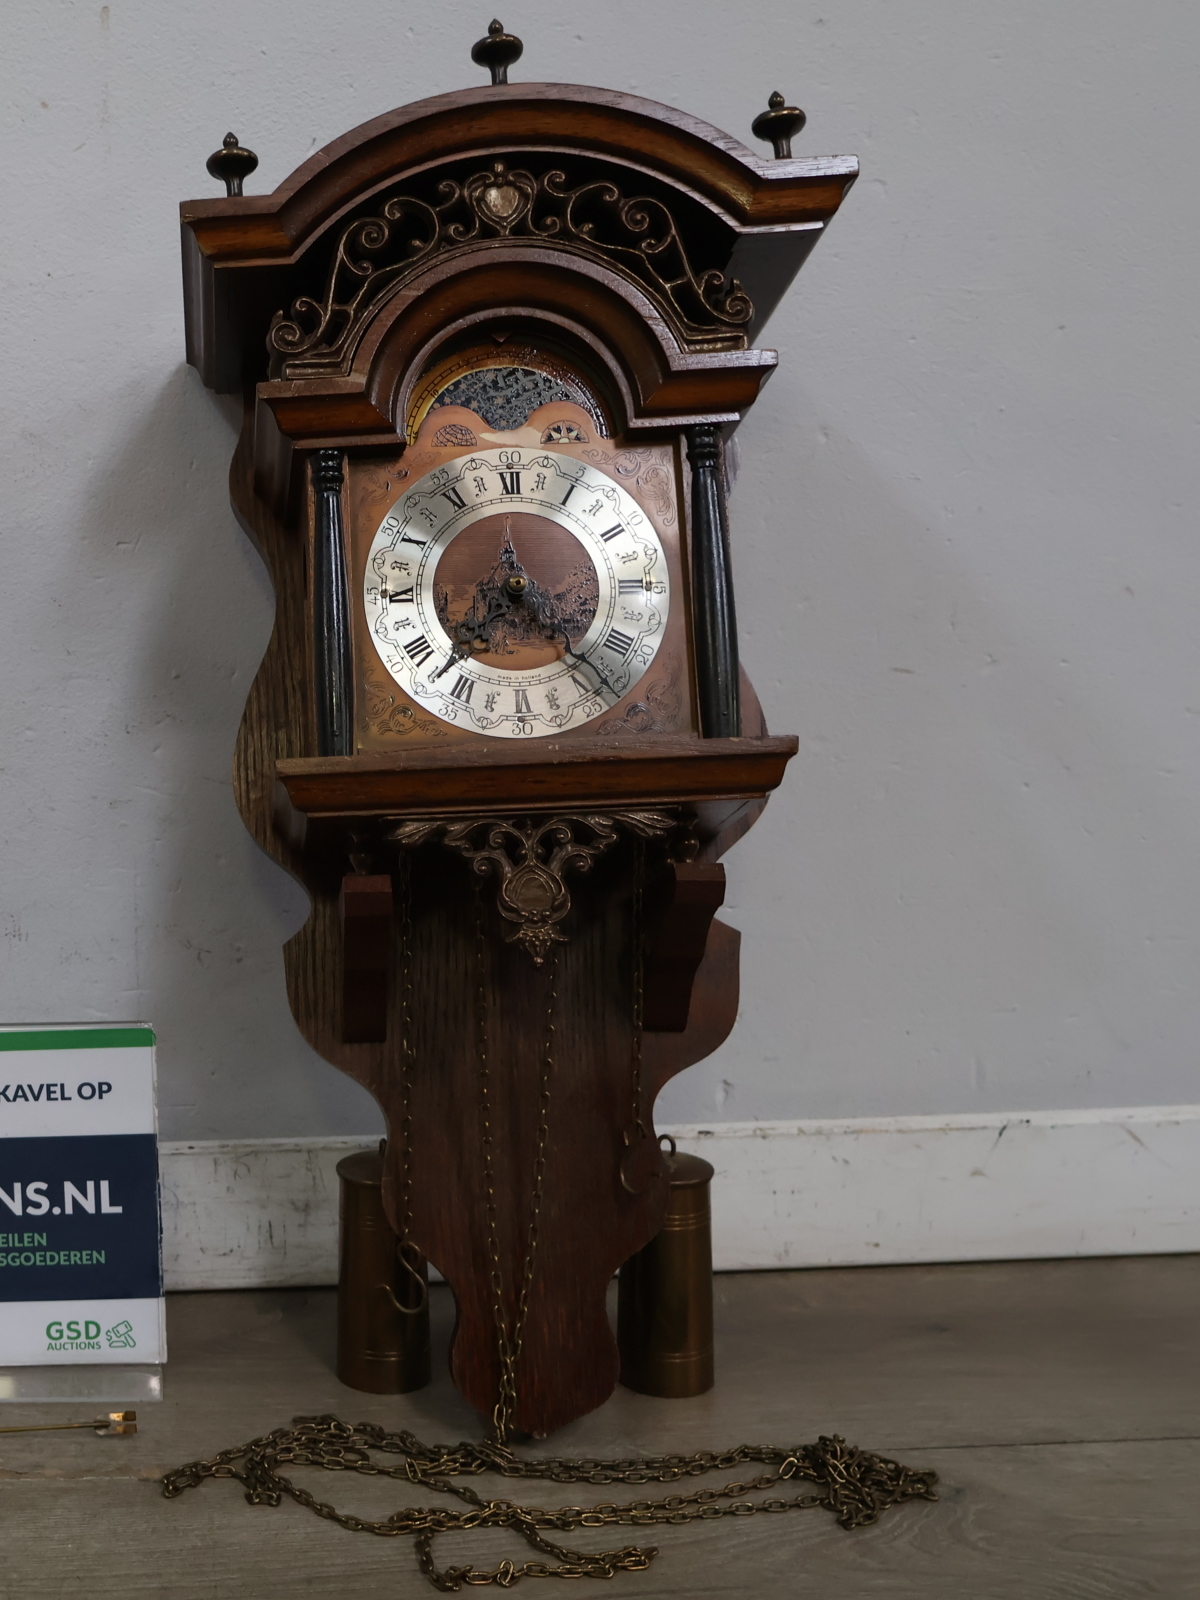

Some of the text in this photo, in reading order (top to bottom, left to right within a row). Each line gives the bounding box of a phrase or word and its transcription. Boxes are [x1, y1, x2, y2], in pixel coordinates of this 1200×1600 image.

[498, 451, 522, 464] 60
[430, 468, 450, 486] 55
[575, 465, 587, 478] 5
[496, 471, 523, 496] XII
[440, 485, 469, 514] XI
[381, 516, 400, 537] 50
[626, 509, 644, 527] 10
[400, 531, 429, 552] X
[599, 521, 627, 545] II
[366, 586, 380, 606] 45
[389, 585, 415, 605] IX
[617, 577, 645, 597] III
[652, 579, 667, 595] 15
[403, 633, 436, 669] VIII
[602, 626, 636, 659] IIII
[386, 653, 404, 675] 40
[635, 644, 655, 666] 20
[448, 673, 478, 705] VII
[568, 673, 593, 699] V
[512, 688, 535, 714] VI
[582, 700, 603, 719] 25
[438, 702, 459, 721] 35
[511, 722, 534, 736] 30
[76, 1081, 113, 1101] OP
[45, 1320, 102, 1341] GSD
[46, 1341, 102, 1352] AUCTIONS
